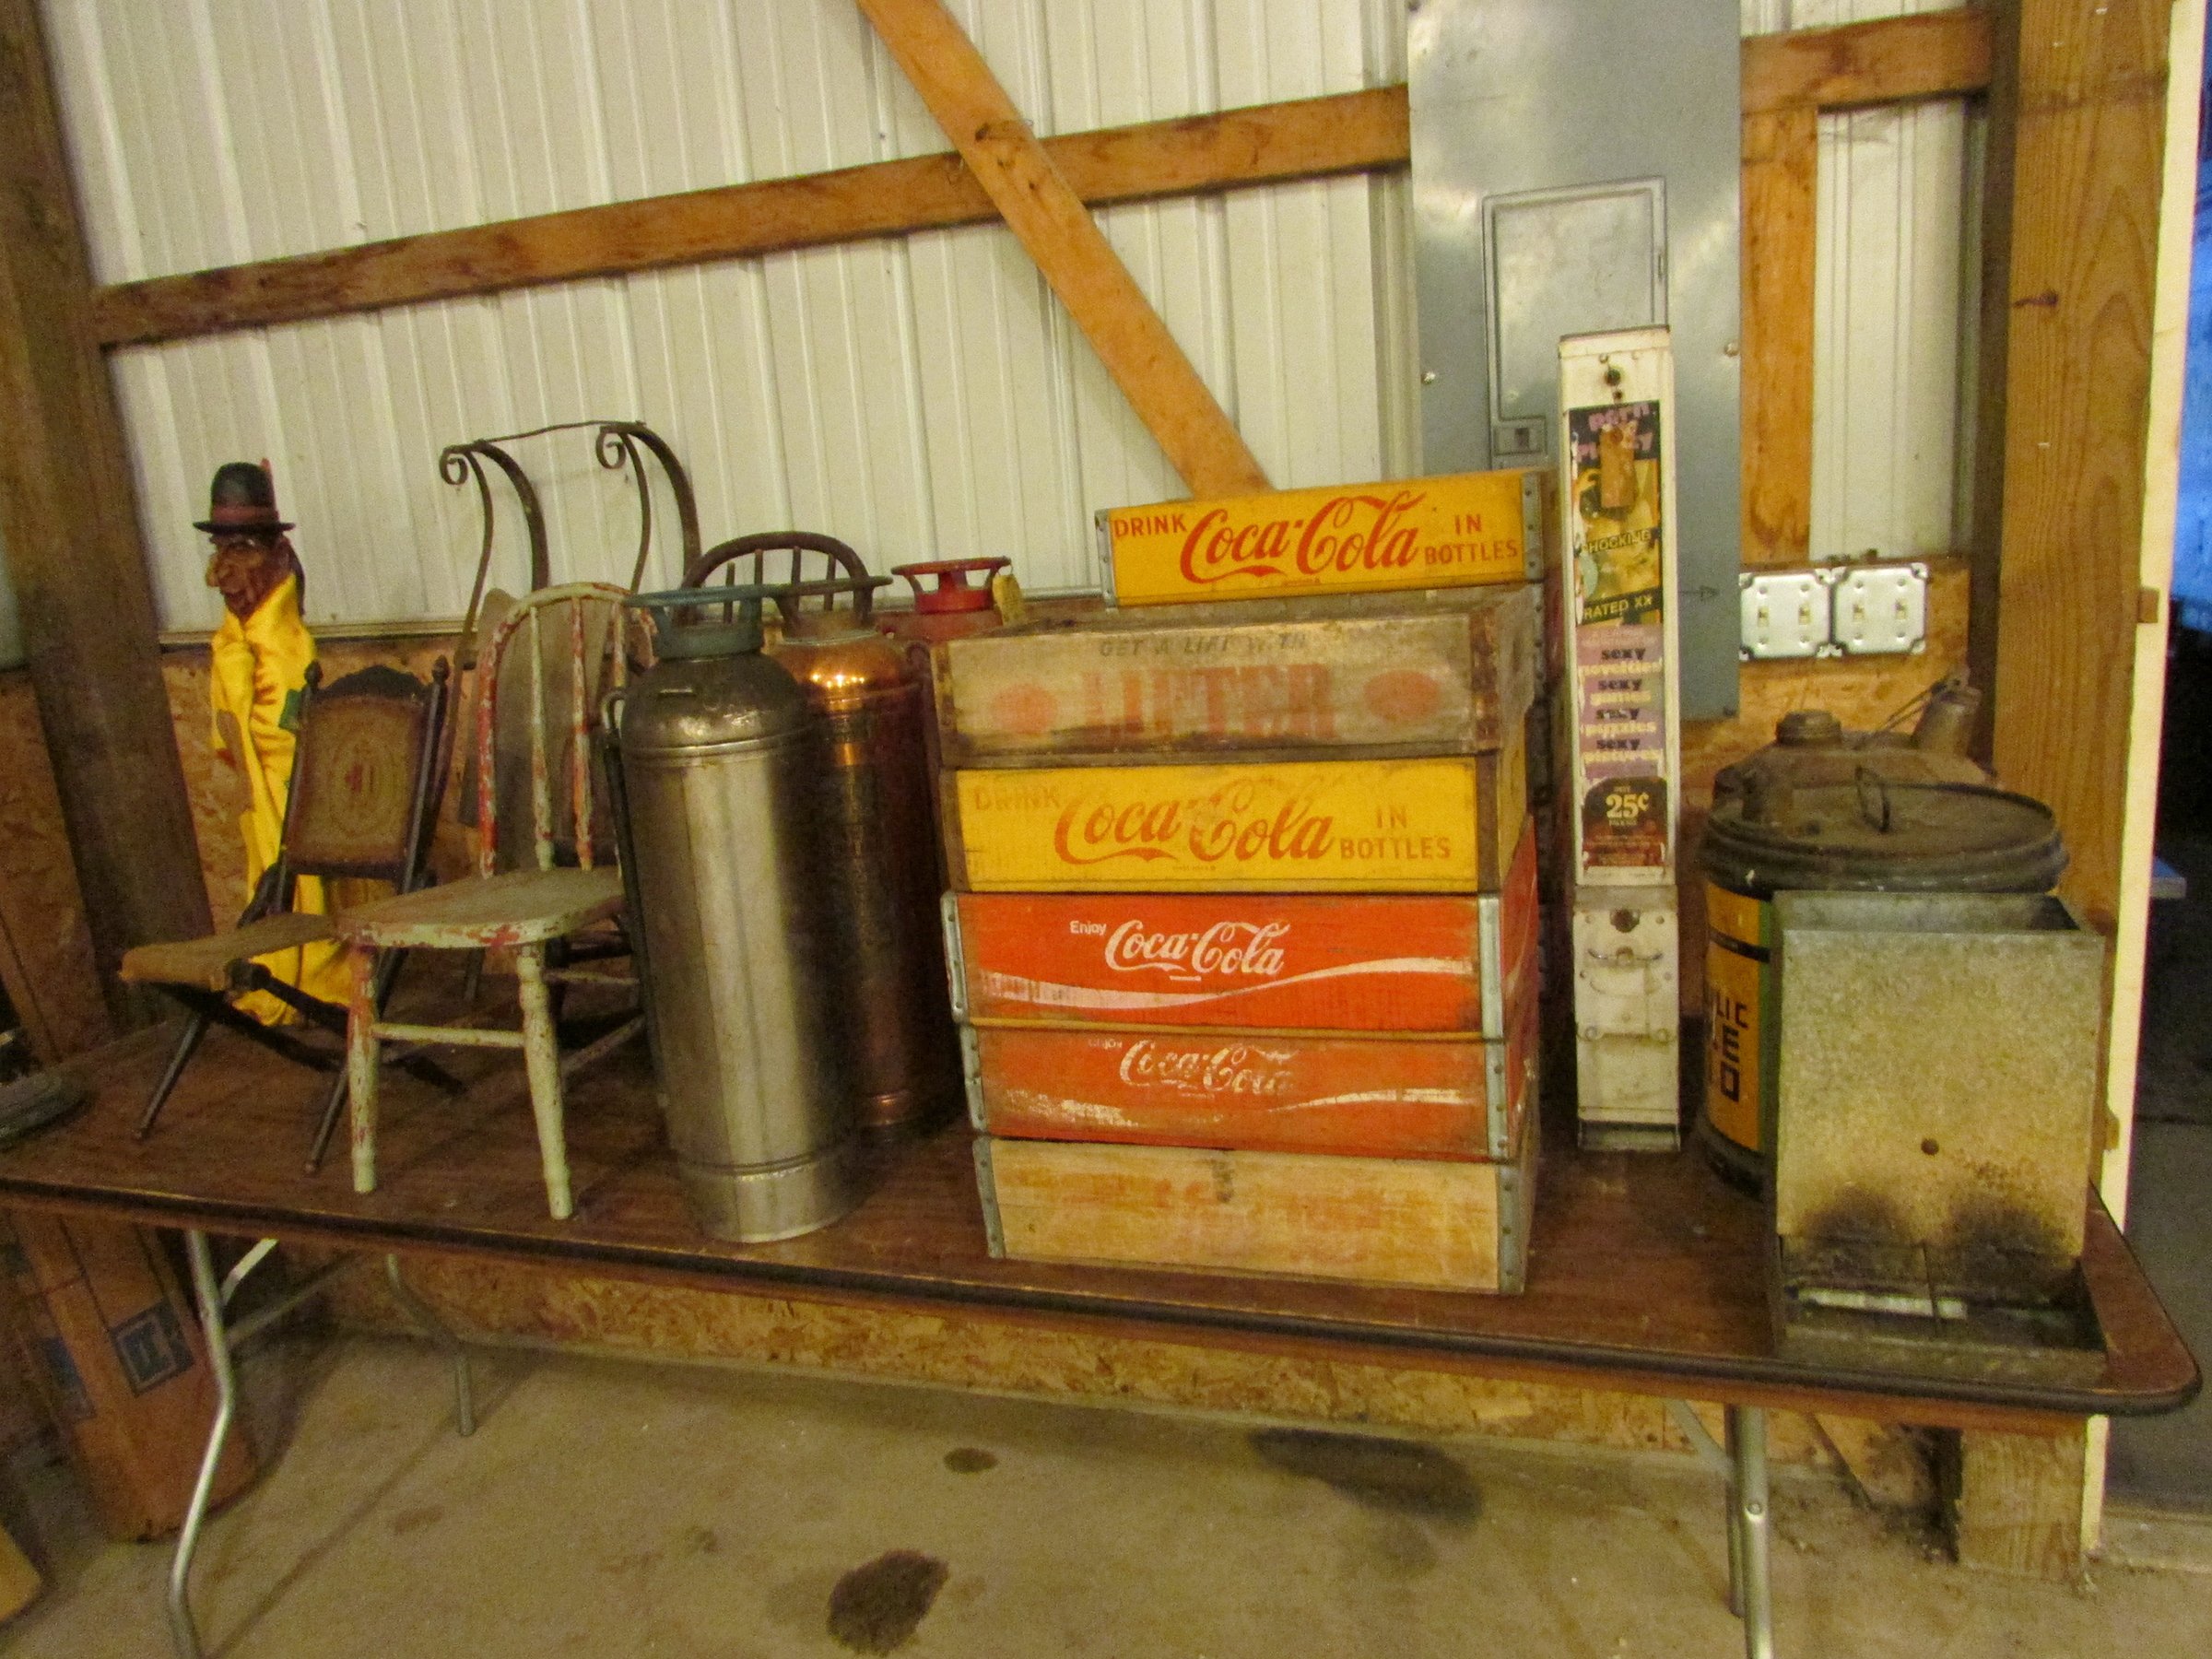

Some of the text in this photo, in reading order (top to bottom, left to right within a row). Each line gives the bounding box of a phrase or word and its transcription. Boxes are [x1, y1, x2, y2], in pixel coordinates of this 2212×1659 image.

[1113, 512, 1187, 539] DRINK
[1454, 513, 1482, 535] IN
[1424, 539, 1519, 566] BOTTLES
[1585, 599, 1629, 618] RATED
[1376, 804, 1407, 830] IN
[1339, 834, 1452, 860] BOTTLES
[1069, 920, 1107, 936] Enjoy
